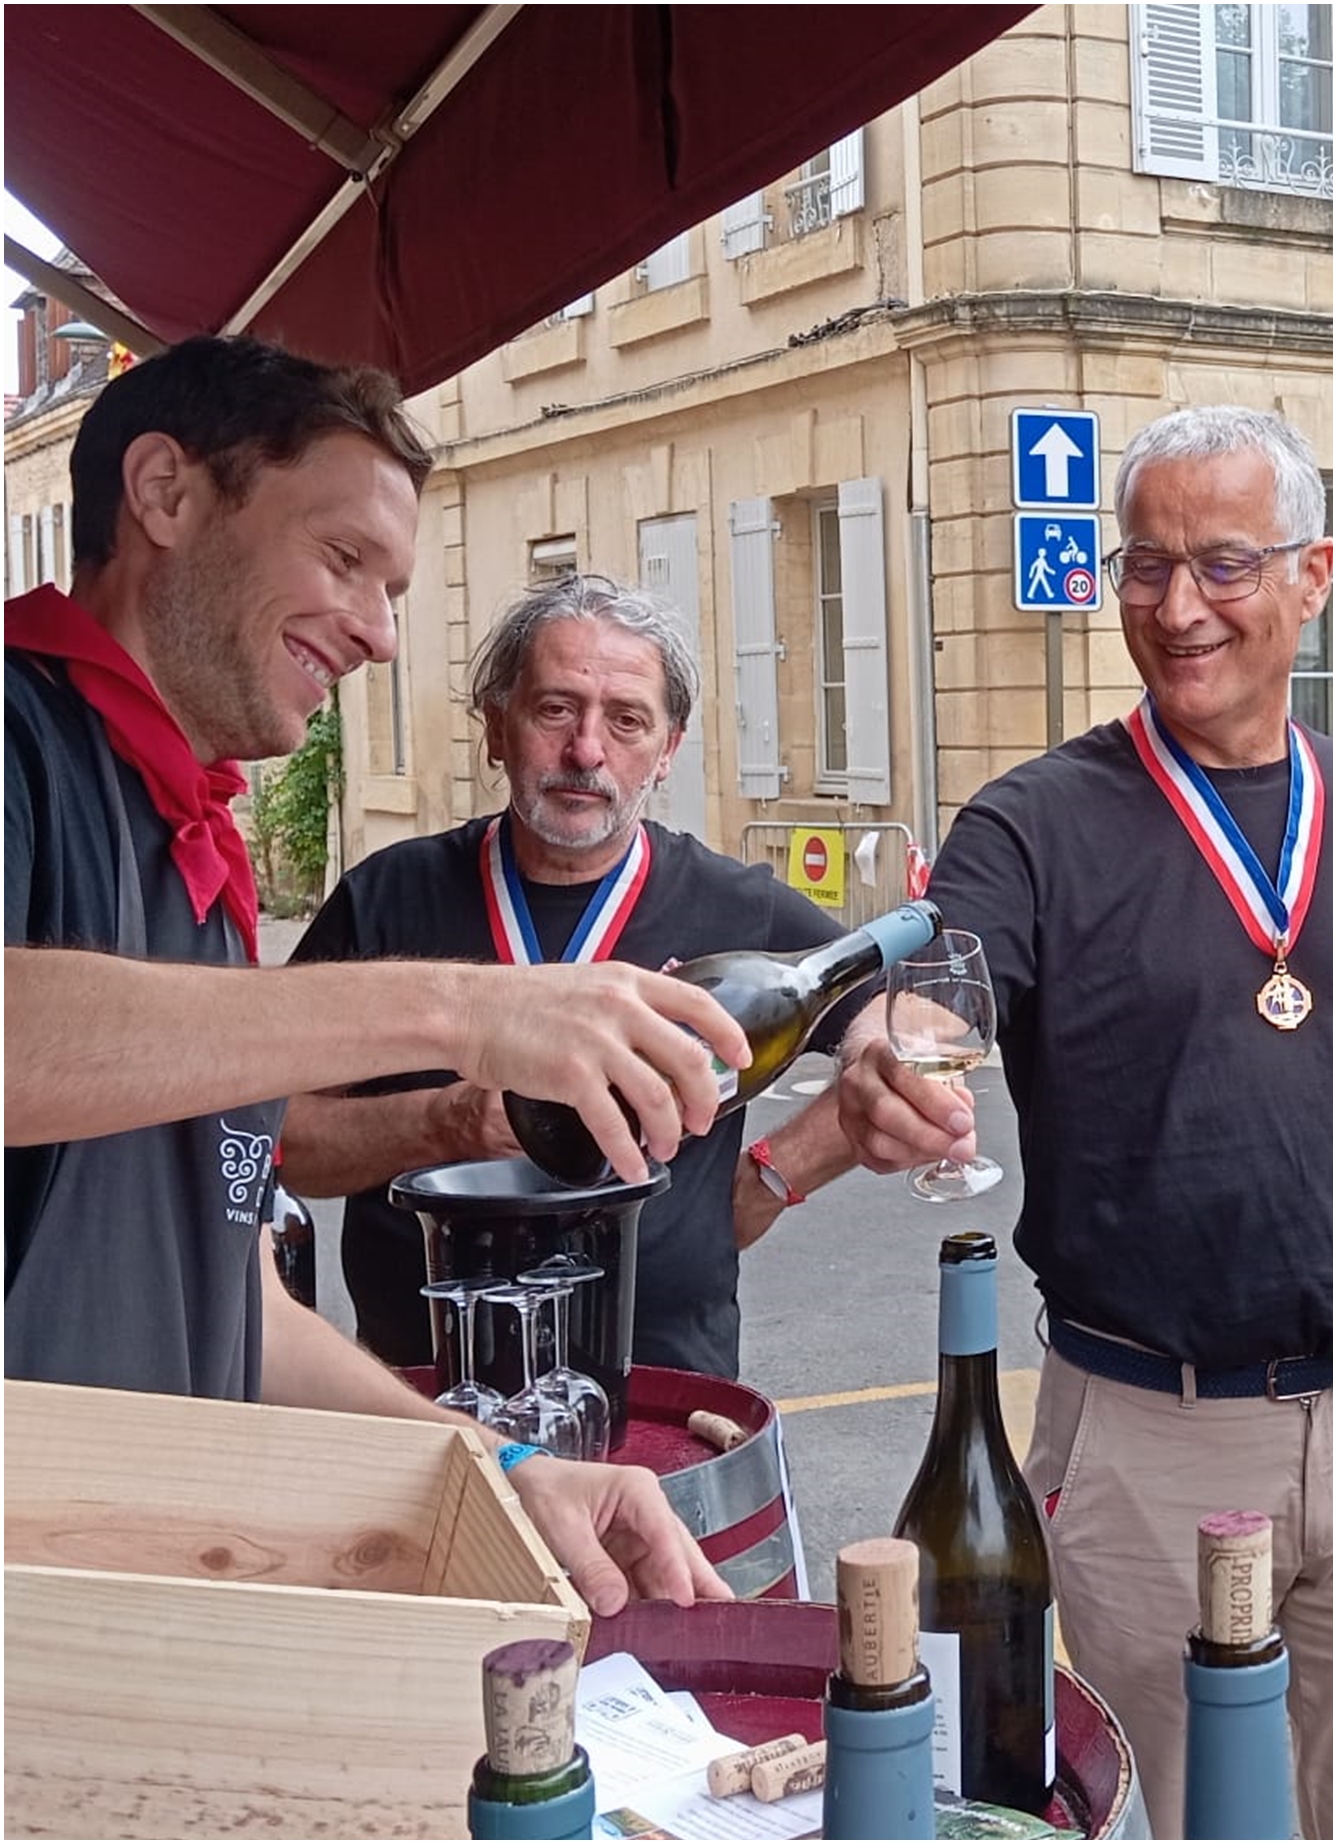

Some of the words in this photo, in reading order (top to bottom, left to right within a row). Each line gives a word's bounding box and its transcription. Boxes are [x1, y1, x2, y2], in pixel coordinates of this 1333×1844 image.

[1071, 580, 1089, 593] 20
[226, 1208, 254, 1225] VINS
[862, 1577, 878, 1681] AUBERTIE
